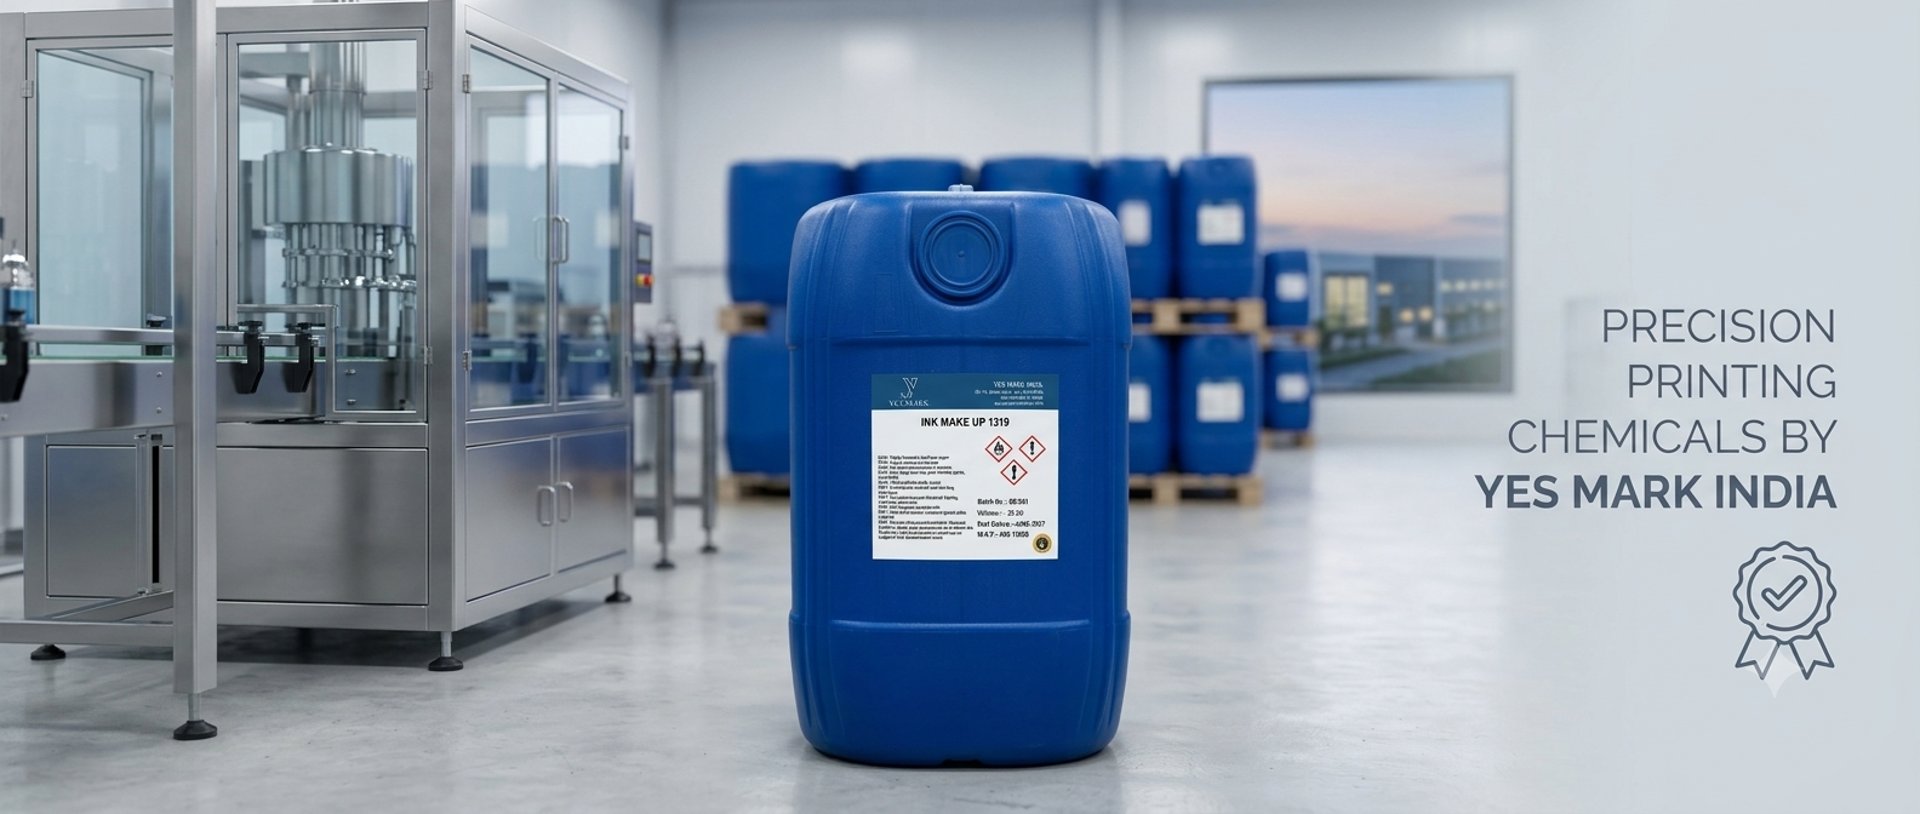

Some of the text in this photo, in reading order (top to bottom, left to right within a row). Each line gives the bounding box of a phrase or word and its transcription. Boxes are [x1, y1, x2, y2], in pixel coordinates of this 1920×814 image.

[920, 417, 1010, 427] INK MAKE UP 1319
